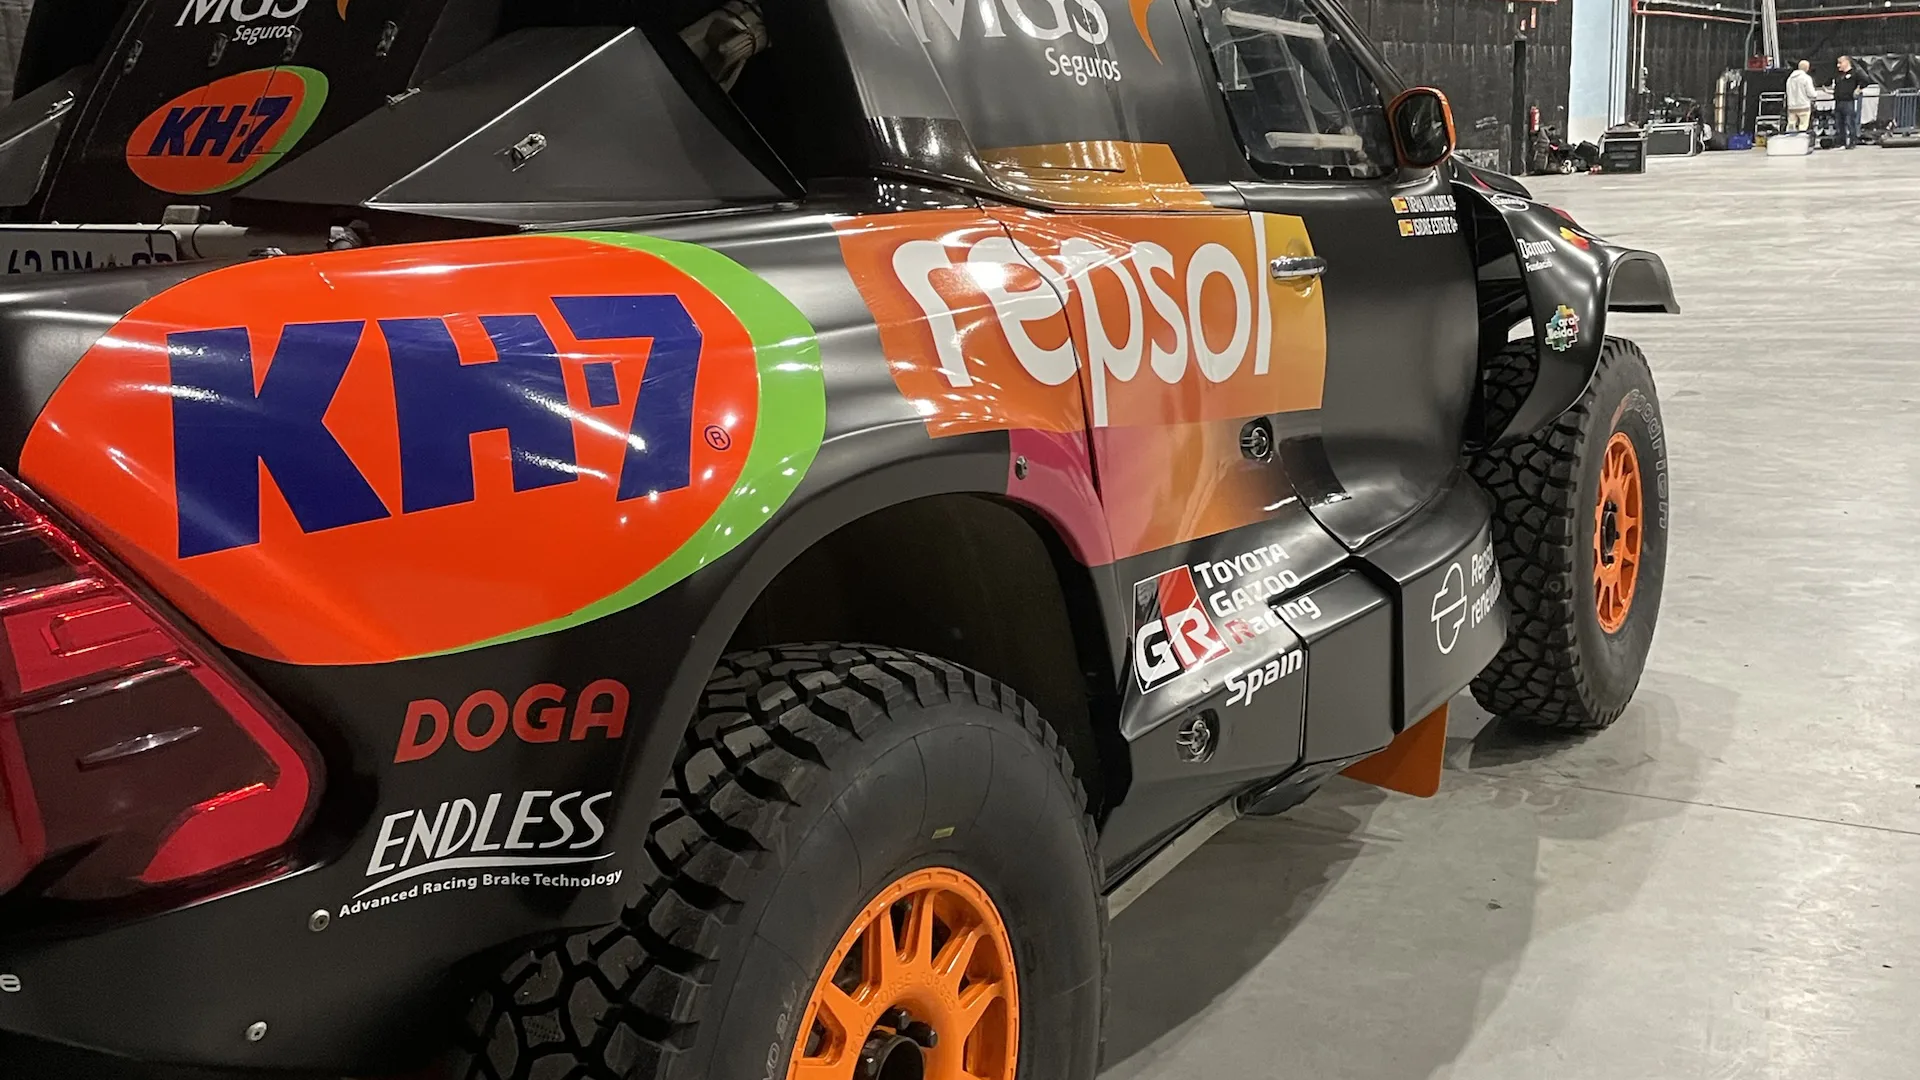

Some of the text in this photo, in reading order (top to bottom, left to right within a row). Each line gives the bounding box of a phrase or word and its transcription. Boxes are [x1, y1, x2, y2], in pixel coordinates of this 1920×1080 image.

[232, 24, 296, 46] Seguros
[1045, 47, 1121, 86] Seguros
[1517, 238, 1556, 259] Damm
[892, 211, 1272, 428] repsol
[1193, 543, 1290, 589] TOYOTA
[1208, 569, 1300, 618] GAZOO
[1135, 606, 1214, 682] GR
[1224, 594, 1322, 645] Racing
[1223, 648, 1303, 707] Spain
[393, 678, 630, 764] DOGA
[365, 790, 613, 877] ENDLESS
[338, 869, 624, 918] Advanced Racing Brake Technology
